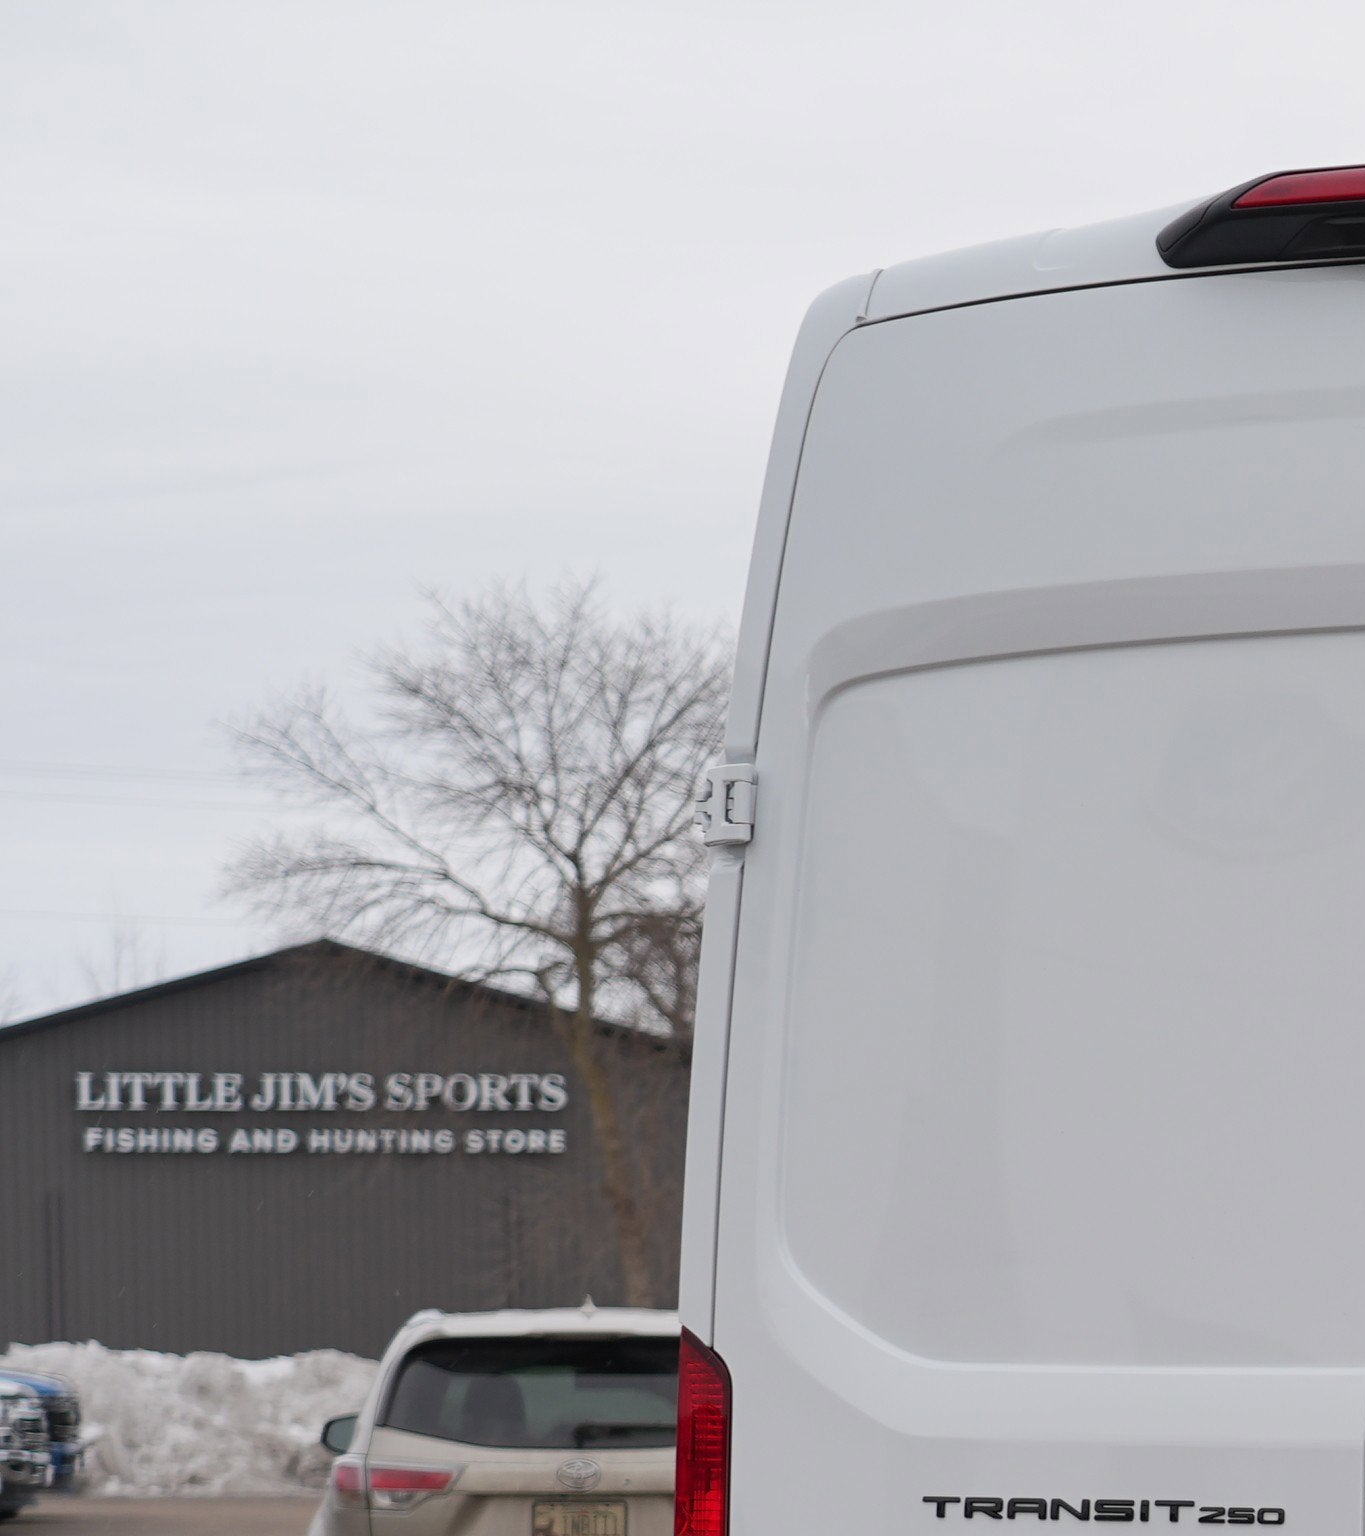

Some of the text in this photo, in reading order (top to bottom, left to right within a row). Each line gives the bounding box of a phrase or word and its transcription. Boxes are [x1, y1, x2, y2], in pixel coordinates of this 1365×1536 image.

[75, 1071, 568, 1112] LITTLE JIM'S SPORTS
[83, 1127, 567, 1154] FISHING AND HUNTING STORE
